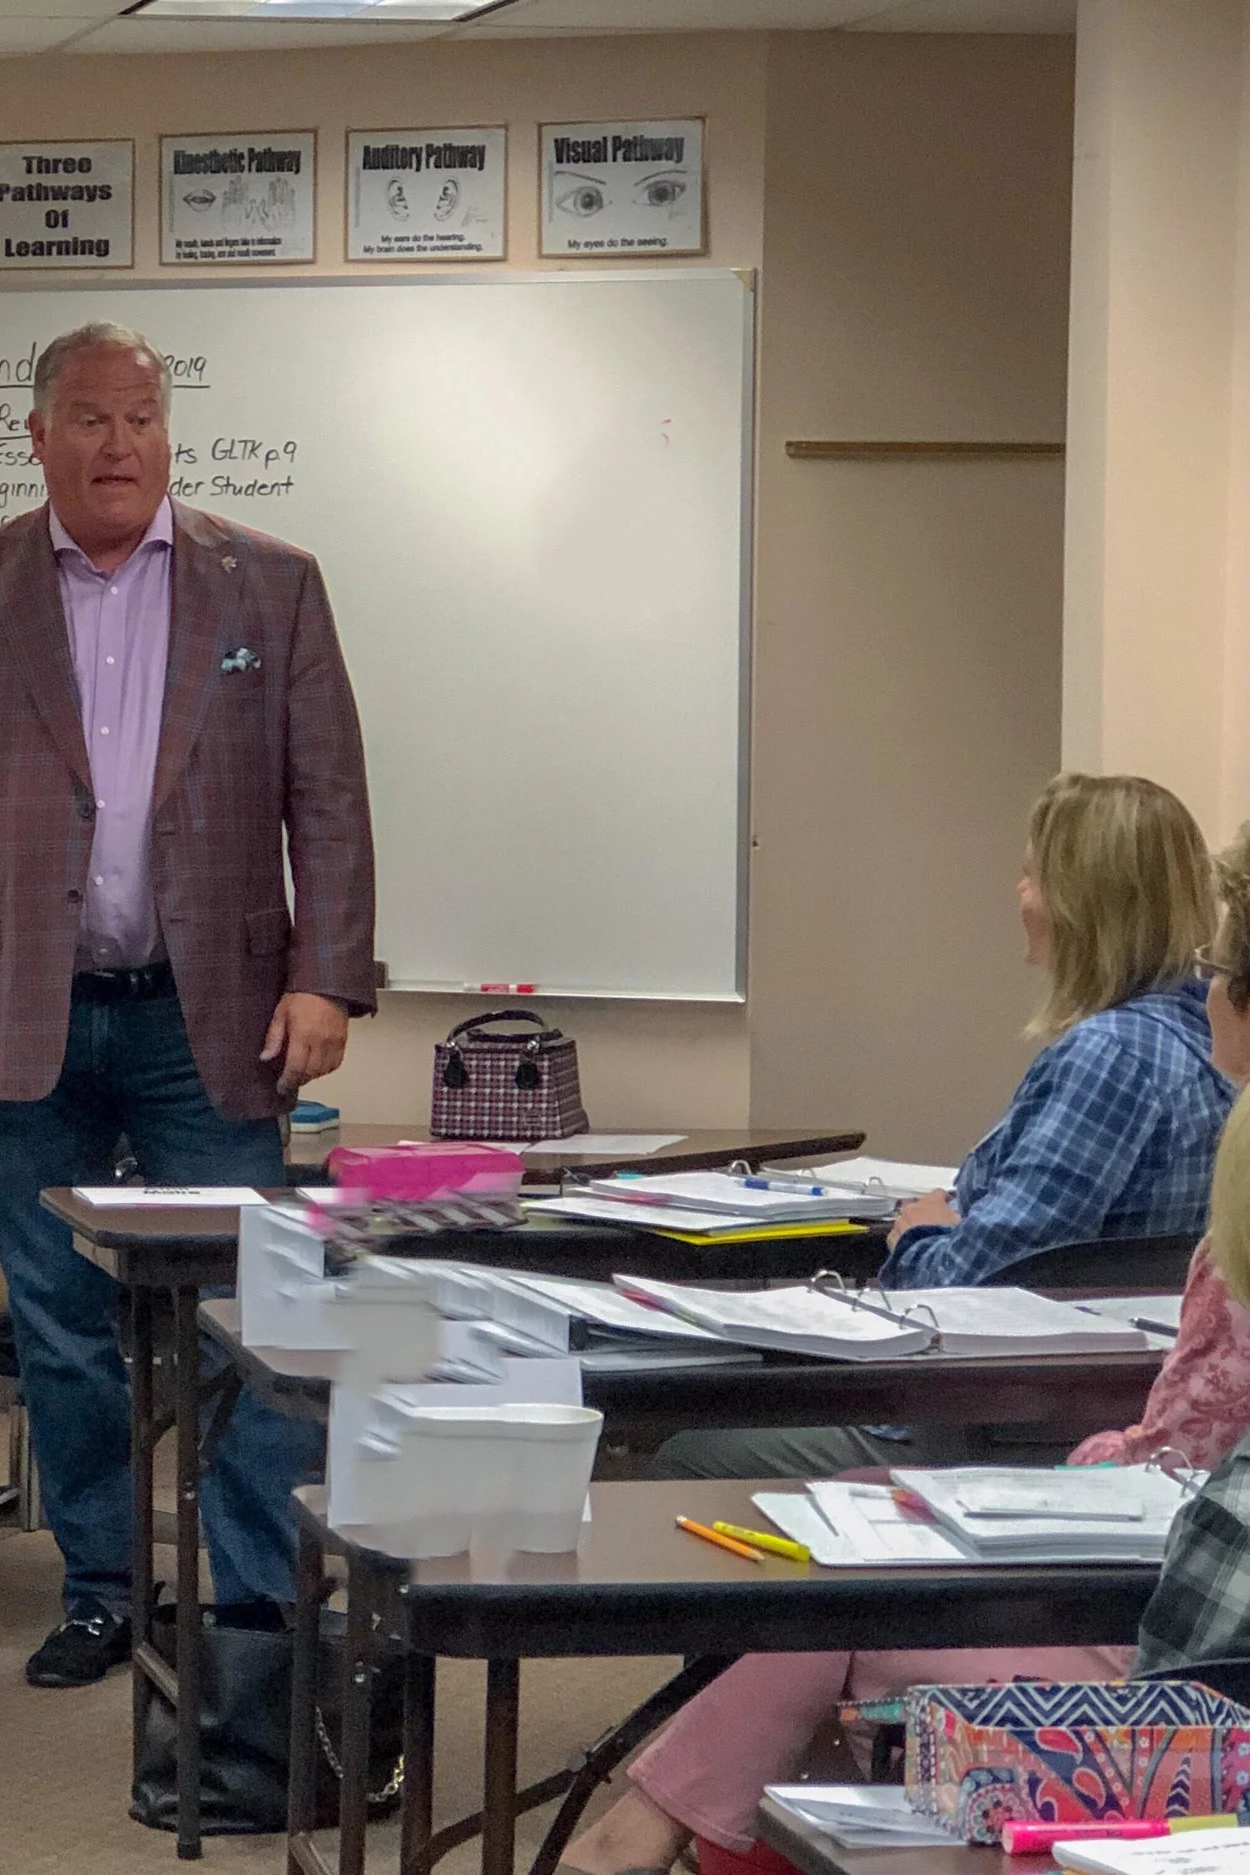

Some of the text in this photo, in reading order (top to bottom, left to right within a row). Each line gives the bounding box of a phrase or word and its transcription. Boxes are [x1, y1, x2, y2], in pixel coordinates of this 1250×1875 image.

[173, 146, 301, 174] Kinesthetic Pathway
[362, 143, 486, 172] Auditory Pathway
[553, 134, 685, 164] Visual Pathway
[22, 156, 92, 174] Three
[45, 209, 69, 229] Of
[5, 236, 110, 258] Learning
[363, 245, 375, 255] My
[416, 244, 427, 252] the
[381, 234, 392, 244] My
[412, 234, 422, 243] do
[423, 234, 435, 242] the
[567, 239, 581, 250] My
[583, 240, 605, 250] eyes
[606, 238, 619, 248] do
[620, 238, 635, 247] the
[211, 437, 263, 462] GLTK
[209, 475, 295, 497] Student
